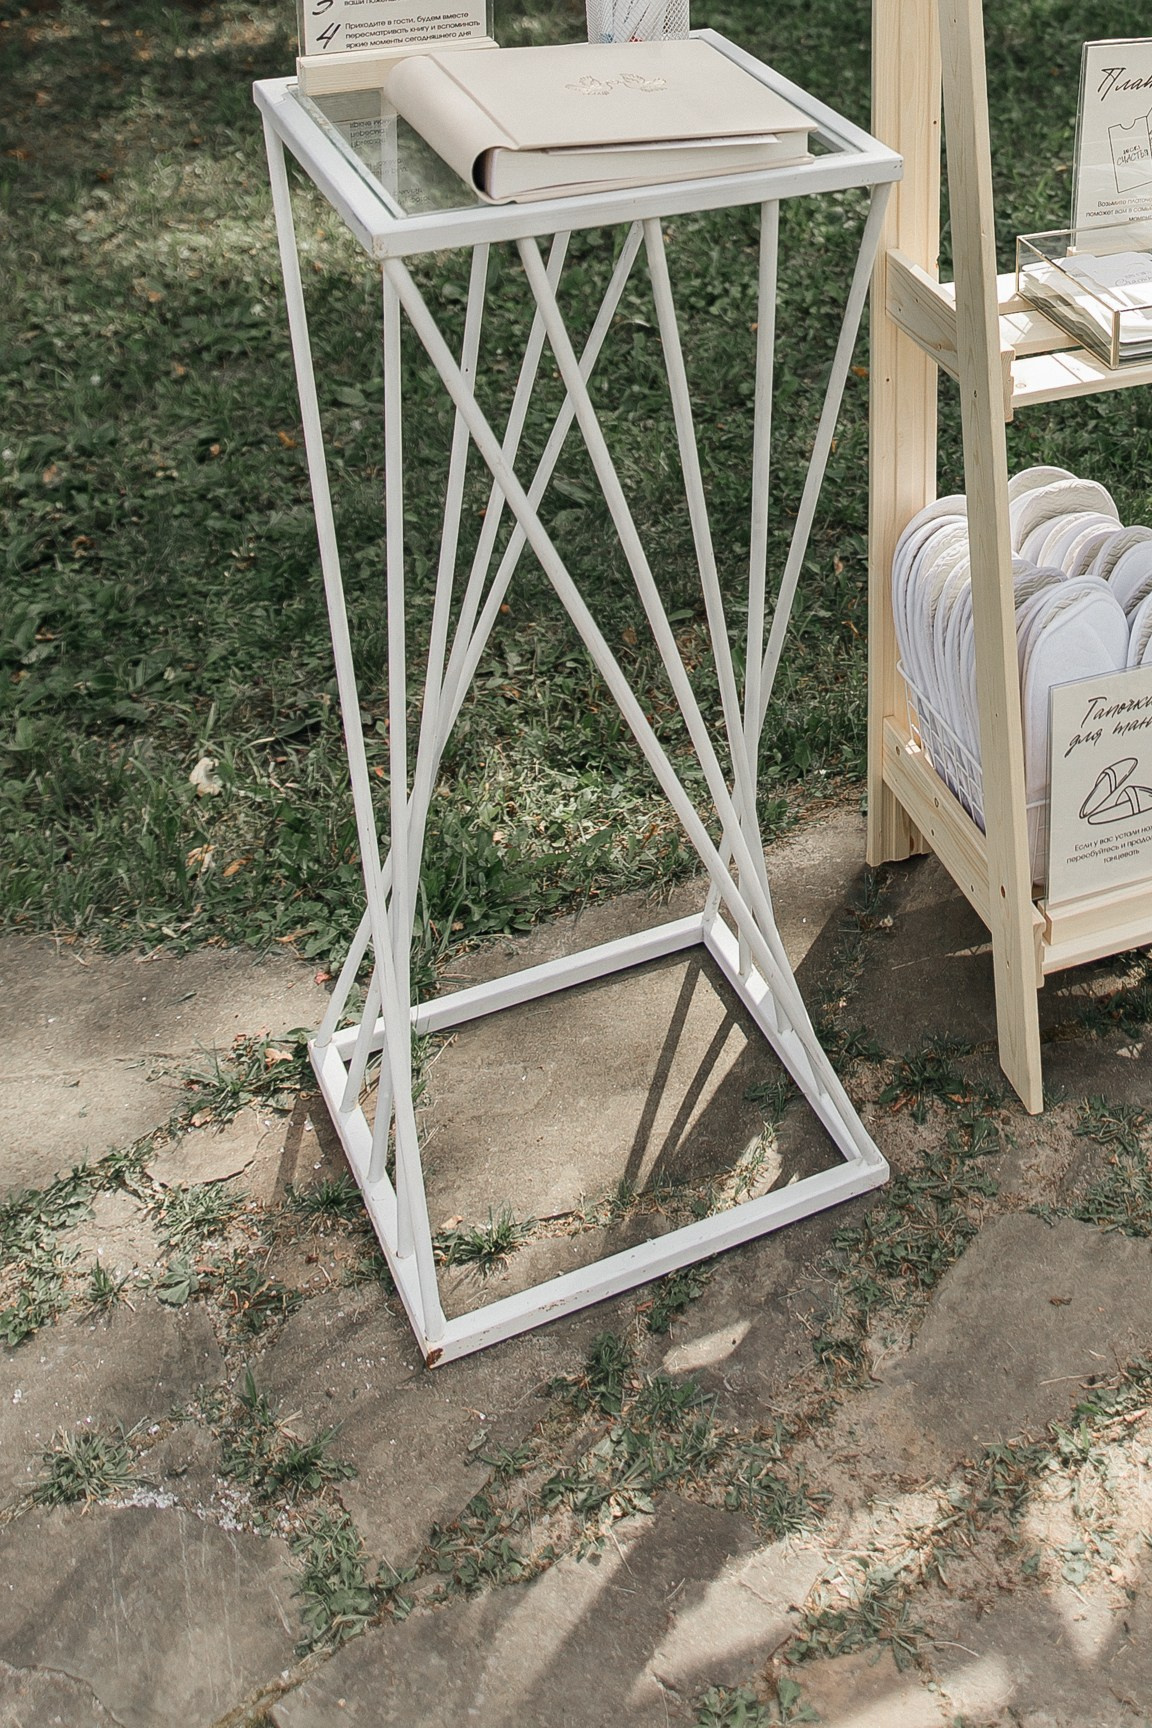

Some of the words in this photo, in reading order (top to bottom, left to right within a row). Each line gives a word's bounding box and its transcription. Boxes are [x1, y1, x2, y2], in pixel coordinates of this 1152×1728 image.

[345, 20, 386, 29] Приходите
[417, 14, 441, 22] будем
[346, 27, 408, 39] пересматривать
[410, 24, 429, 33] книгу
[438, 21, 480, 30] вспоминать
[316, 23, 341, 49] 4
[370, 37, 403, 46] моменты
[1064, 729, 1103, 758] для
[1074, 842, 1093, 852] Если
[1100, 836, 1113, 844] вас
[1115, 829, 1140, 842] устали
[1104, 849, 1139, 863] танцевать
